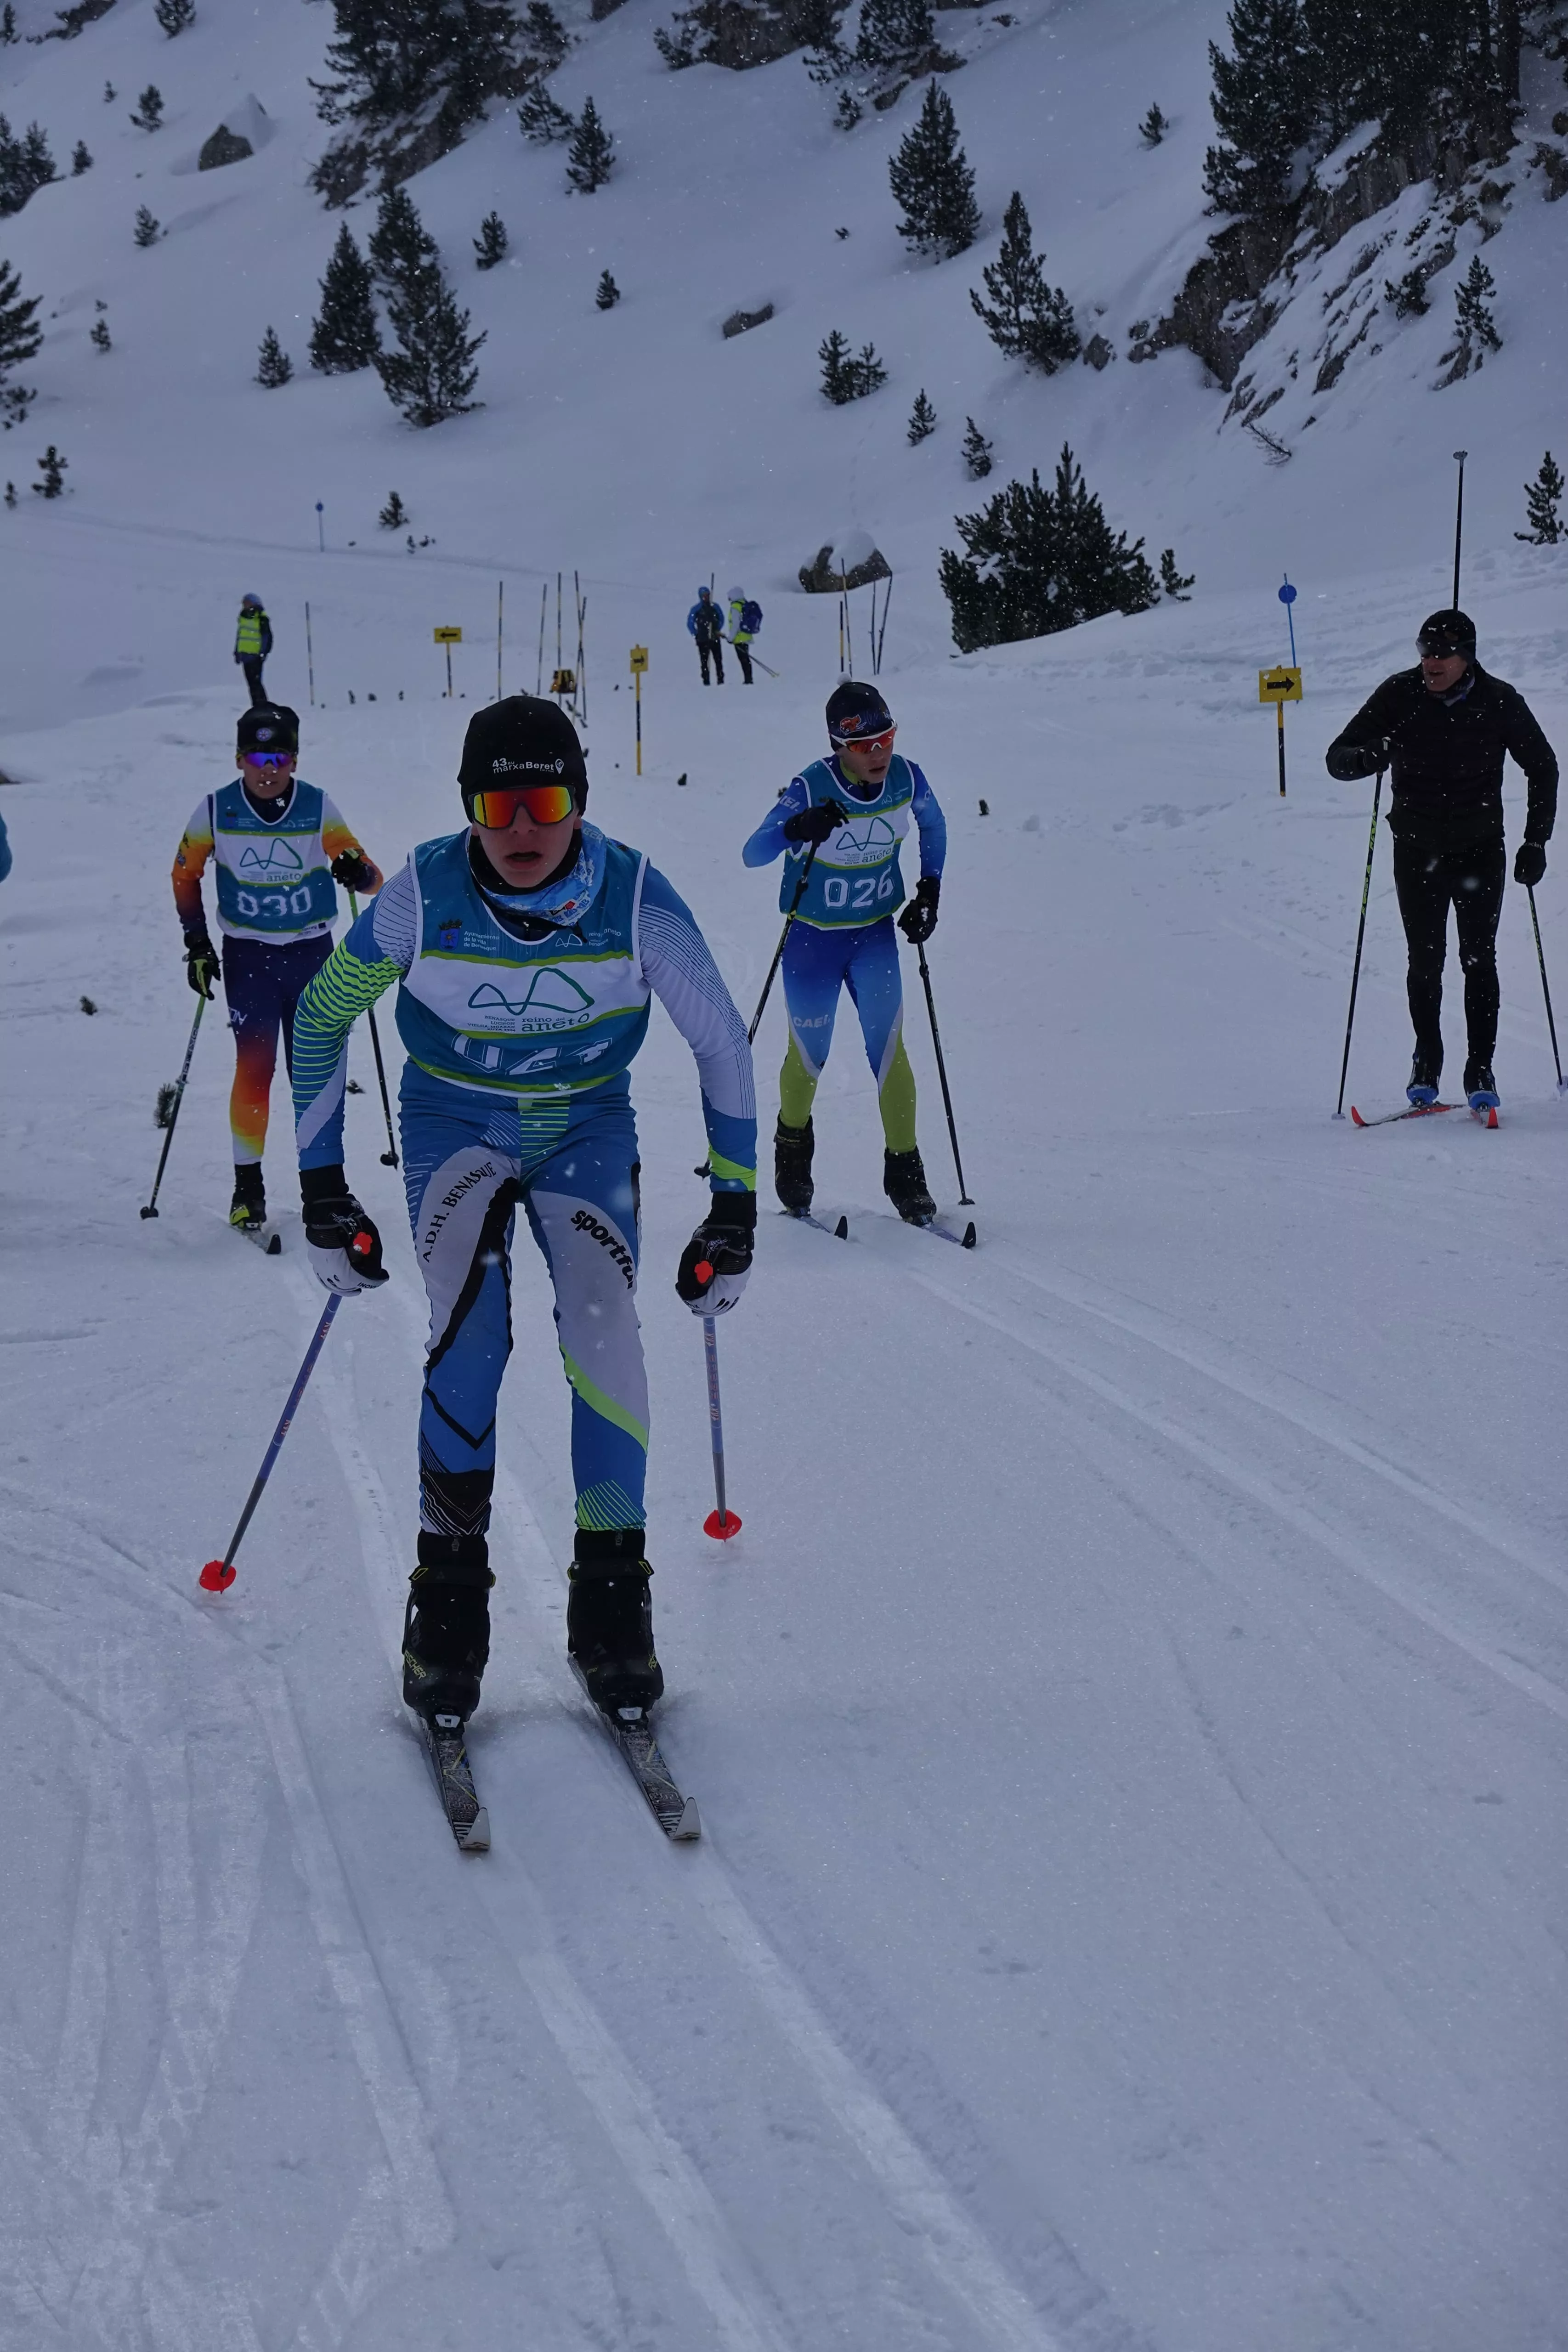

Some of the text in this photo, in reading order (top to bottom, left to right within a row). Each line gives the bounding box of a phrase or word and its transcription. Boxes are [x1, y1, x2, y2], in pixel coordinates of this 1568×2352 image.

[862, 848, 891, 863] aneto
[266, 873, 301, 882] aneto
[824, 865, 894, 909] 026
[237, 887, 311, 917] 030
[464, 931, 500, 940] Ayuntamiento
[604, 928, 621, 936] aneto
[521, 1013, 589, 1032] aneto
[423, 1161, 497, 1263] A.D.H. BENASQUE
